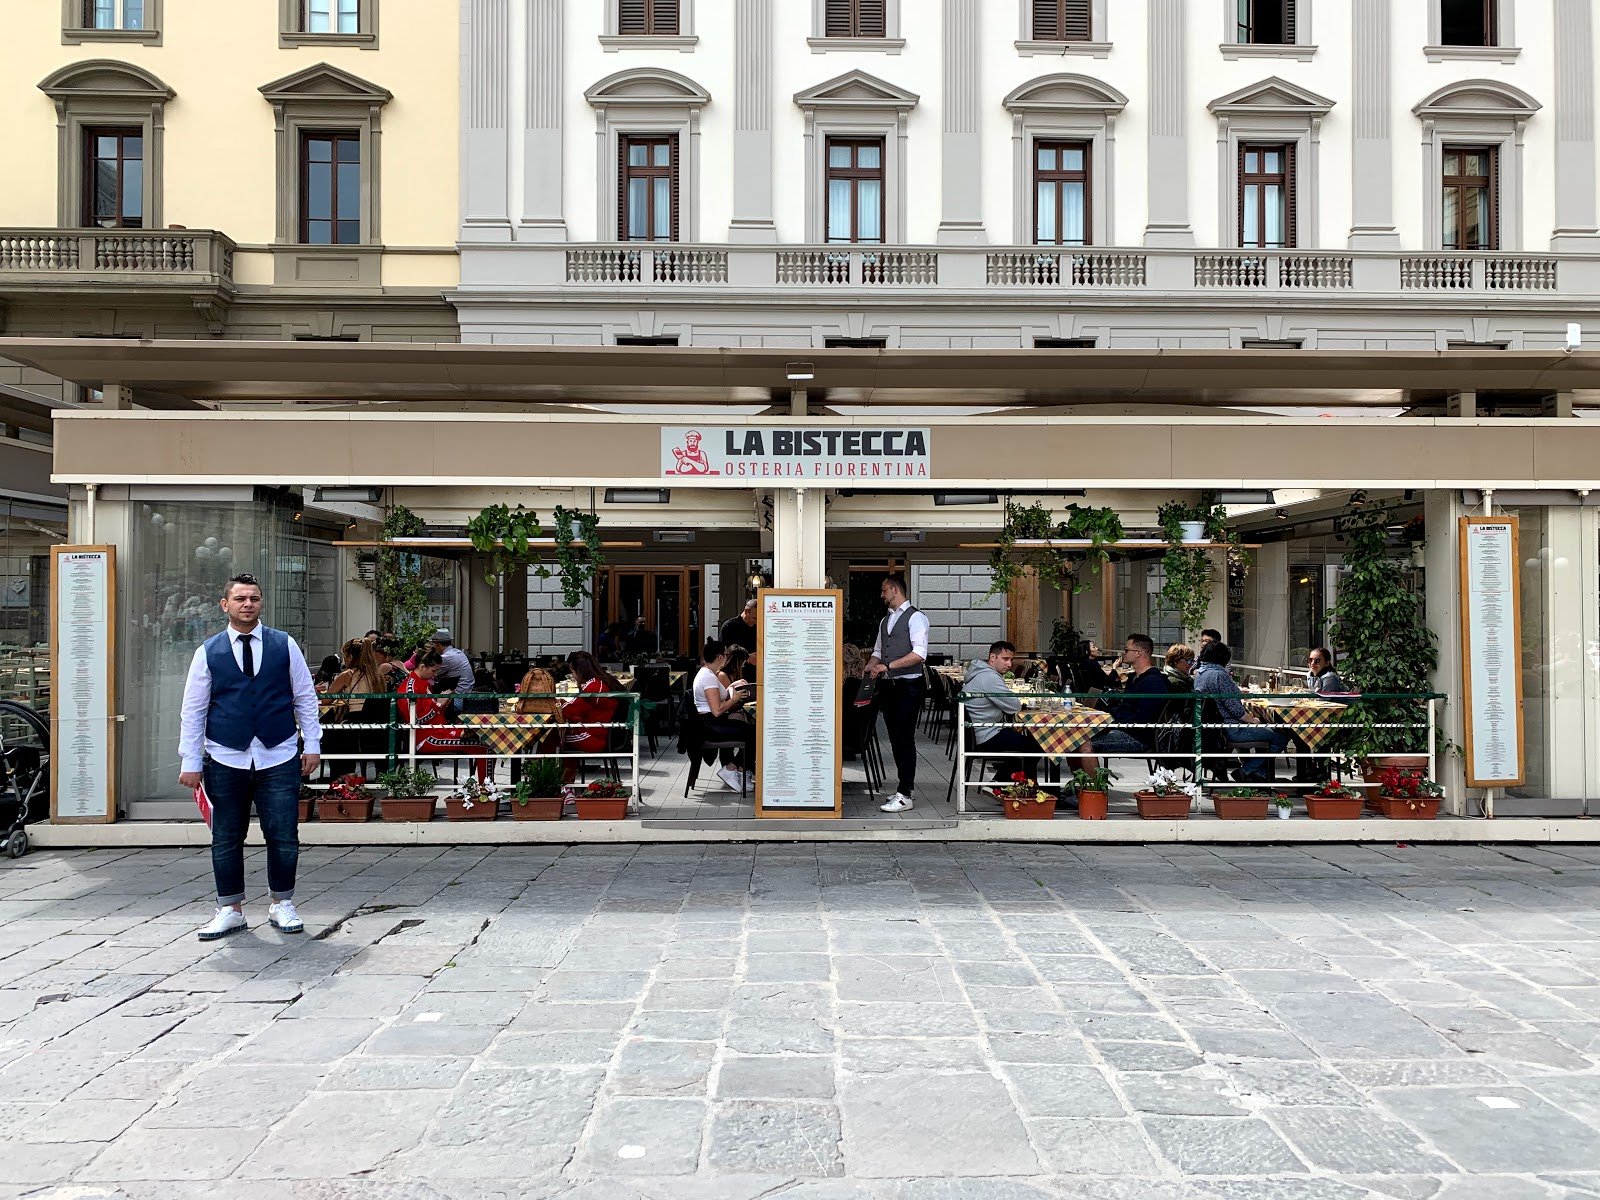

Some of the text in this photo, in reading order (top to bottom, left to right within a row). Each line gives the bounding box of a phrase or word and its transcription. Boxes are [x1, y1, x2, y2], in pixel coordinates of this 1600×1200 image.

[725, 430, 927, 456] LA BISTECCA
[725, 462, 927, 476] OSTERIA FIORENTINA
[793, 601, 833, 609] BISTECCA
